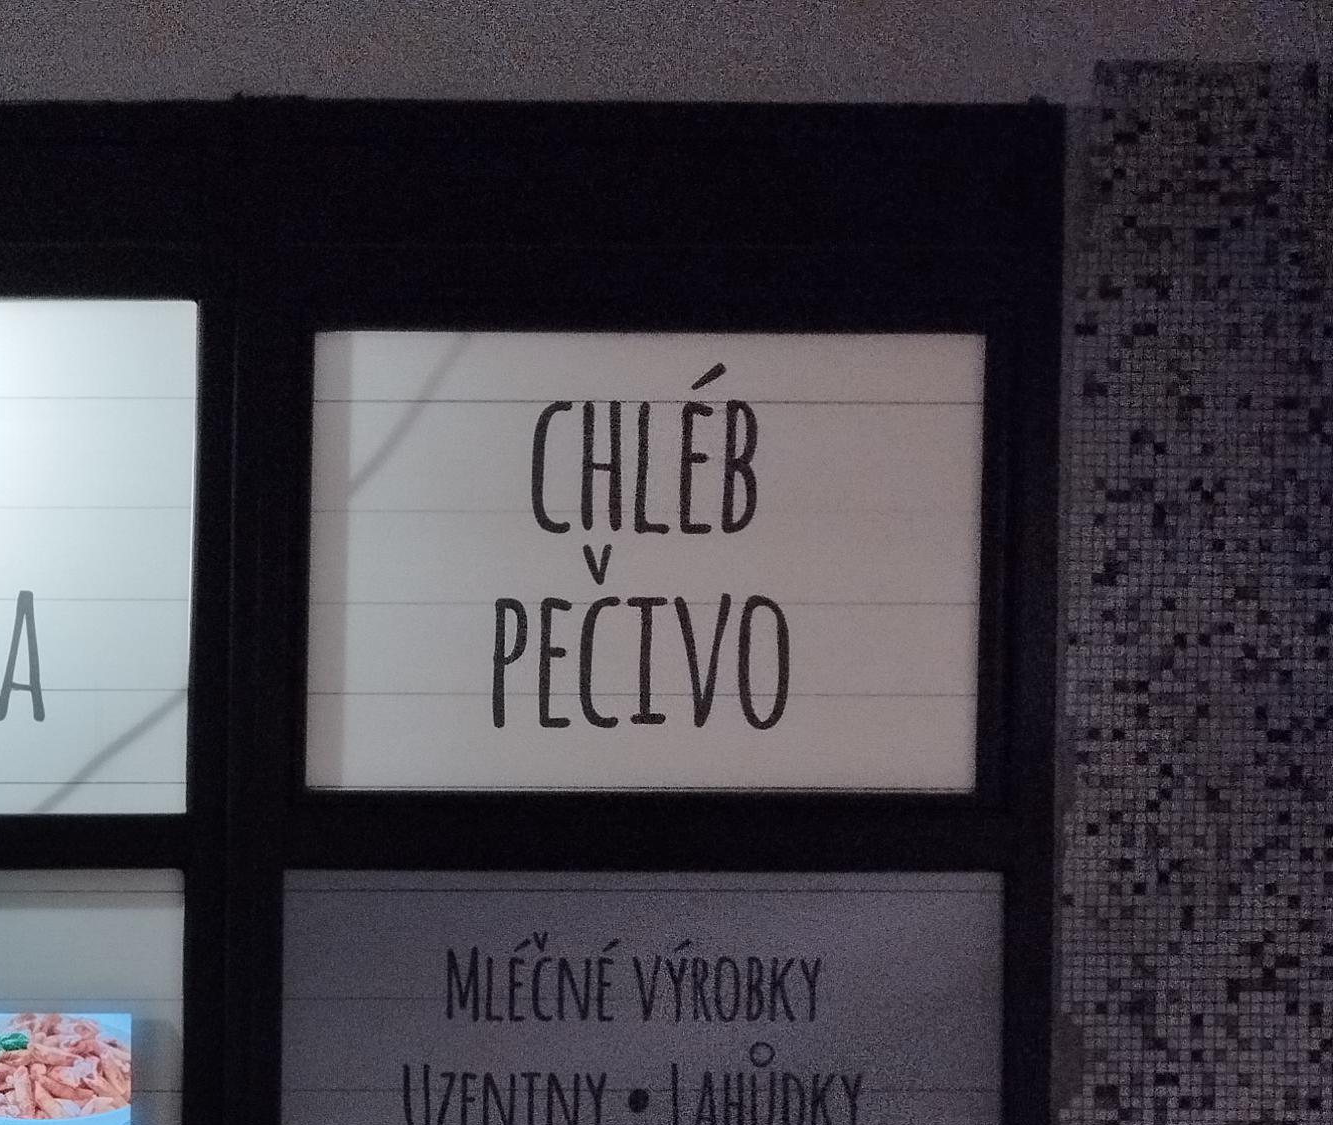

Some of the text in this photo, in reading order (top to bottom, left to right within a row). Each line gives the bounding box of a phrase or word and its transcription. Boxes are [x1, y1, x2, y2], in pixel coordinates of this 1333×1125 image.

[531, 362, 758, 534] CHLÉB
[492, 544, 790, 730] PEČIVO
[632, 938, 823, 1023] VÝROBKY
